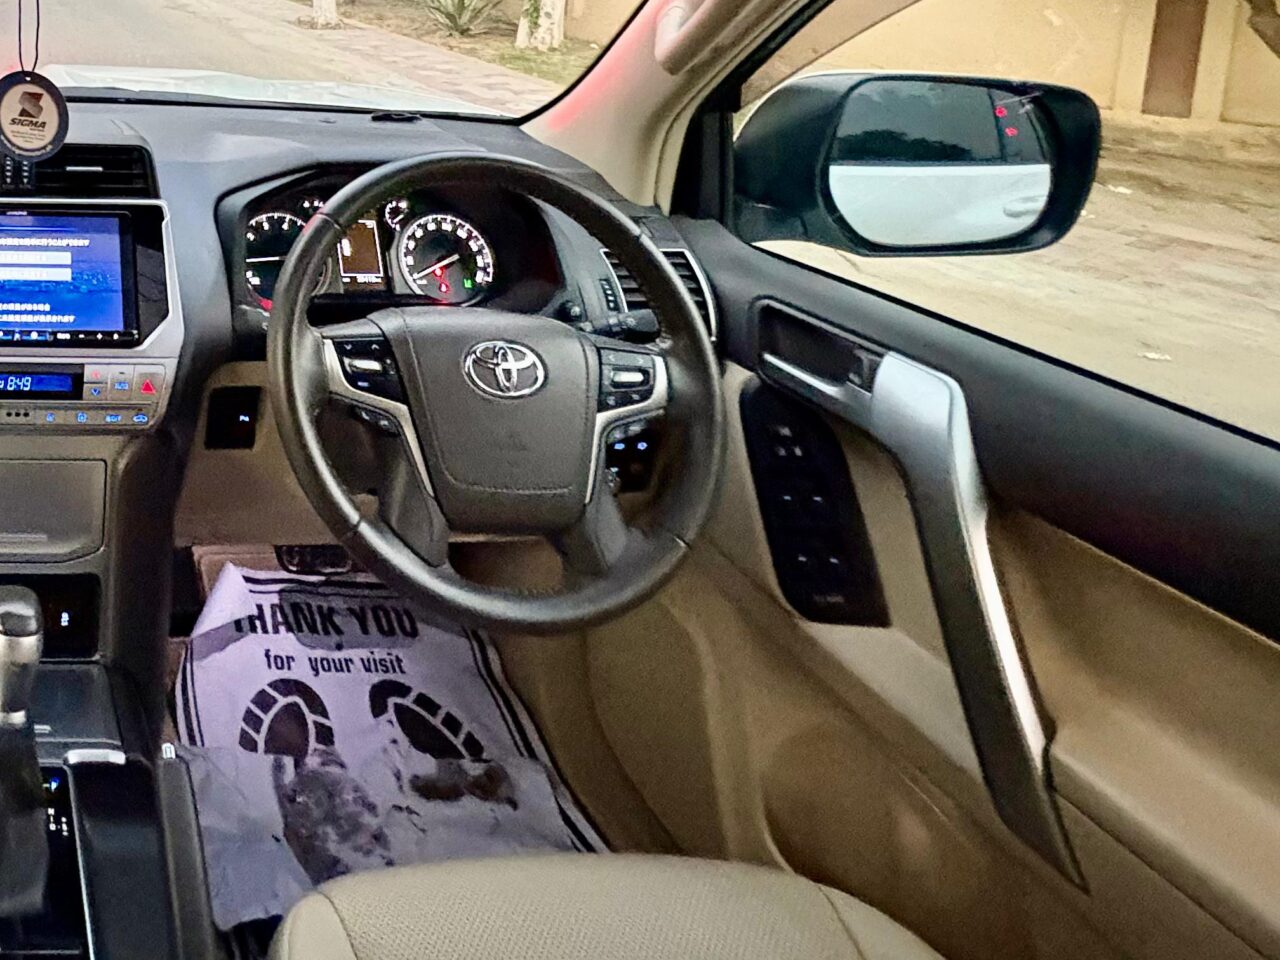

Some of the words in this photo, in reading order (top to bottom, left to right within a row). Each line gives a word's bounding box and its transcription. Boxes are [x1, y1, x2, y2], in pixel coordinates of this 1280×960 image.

[8, 117, 47, 129] SIGMA
[6, 376, 32, 391] 8:49
[346, 603, 420, 639] YOU
[265, 648, 296, 671] for
[308, 655, 355, 677] your
[360, 650, 407, 675] visit
